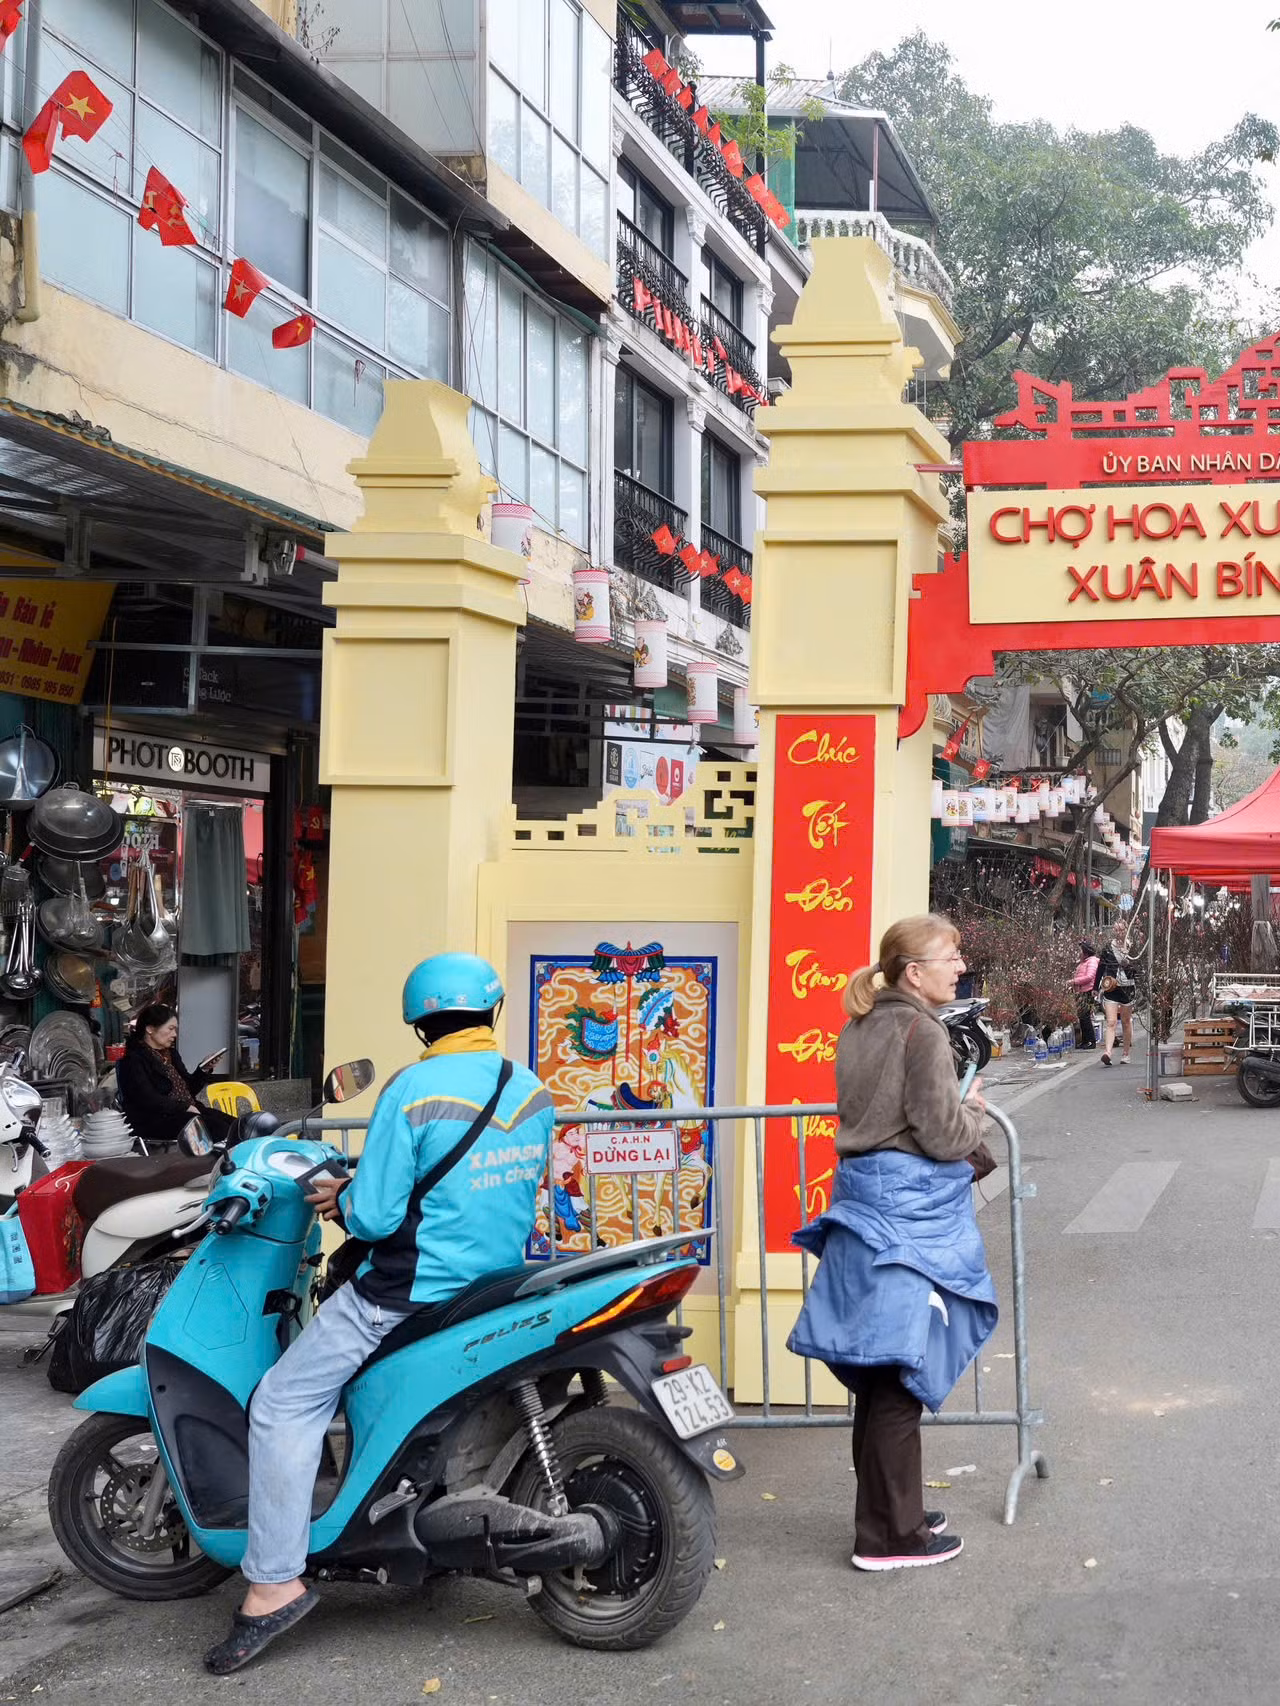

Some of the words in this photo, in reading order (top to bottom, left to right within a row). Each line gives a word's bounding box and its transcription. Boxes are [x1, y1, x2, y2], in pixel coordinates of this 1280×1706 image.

[1102, 451, 1132, 474] ỦY
[1137, 455, 1182, 473] BAN
[1190, 452, 1253, 472] NHÂN
[989, 504, 1096, 549] CHỢ
[1107, 503, 1207, 541] HOA
[1067, 556, 1198, 603] XUÂN
[787, 729, 861, 765] Chúc
[802, 799, 851, 849] Tết
[784, 875, 853, 913] Đến
[593, 1145, 639, 1163] DỪNG
[643, 1148, 671, 1164] LẠI
[611, 1135, 651, 1145] C.A.H.N
[470, 1172, 502, 1192] xin
